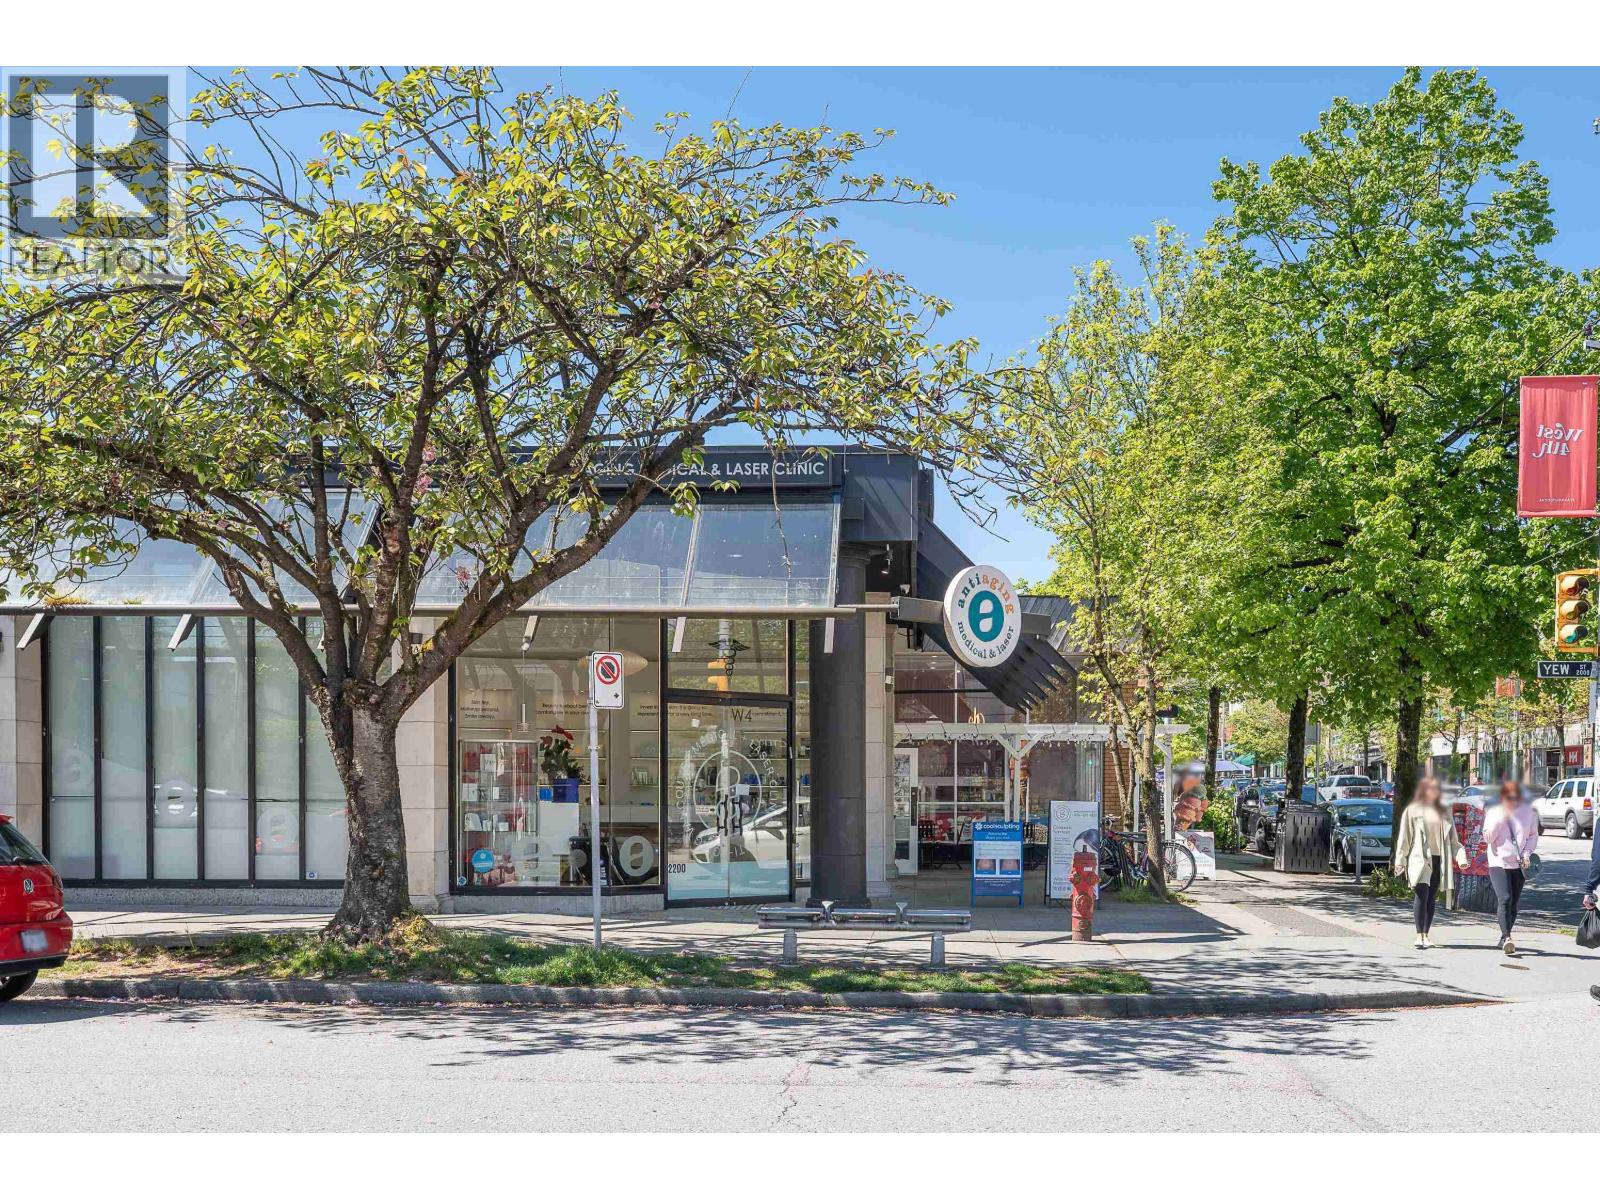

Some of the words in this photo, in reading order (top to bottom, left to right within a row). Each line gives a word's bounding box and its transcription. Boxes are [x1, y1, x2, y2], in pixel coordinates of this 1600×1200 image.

[711, 463, 721, 475] &
[726, 463, 769, 475] LASER
[775, 462, 825, 475] CLINIC
[957, 621, 987, 659] medical
[997, 625, 1014, 655] laser
[1543, 664, 1570, 675] YEW
[668, 864, 686, 874] 2200
